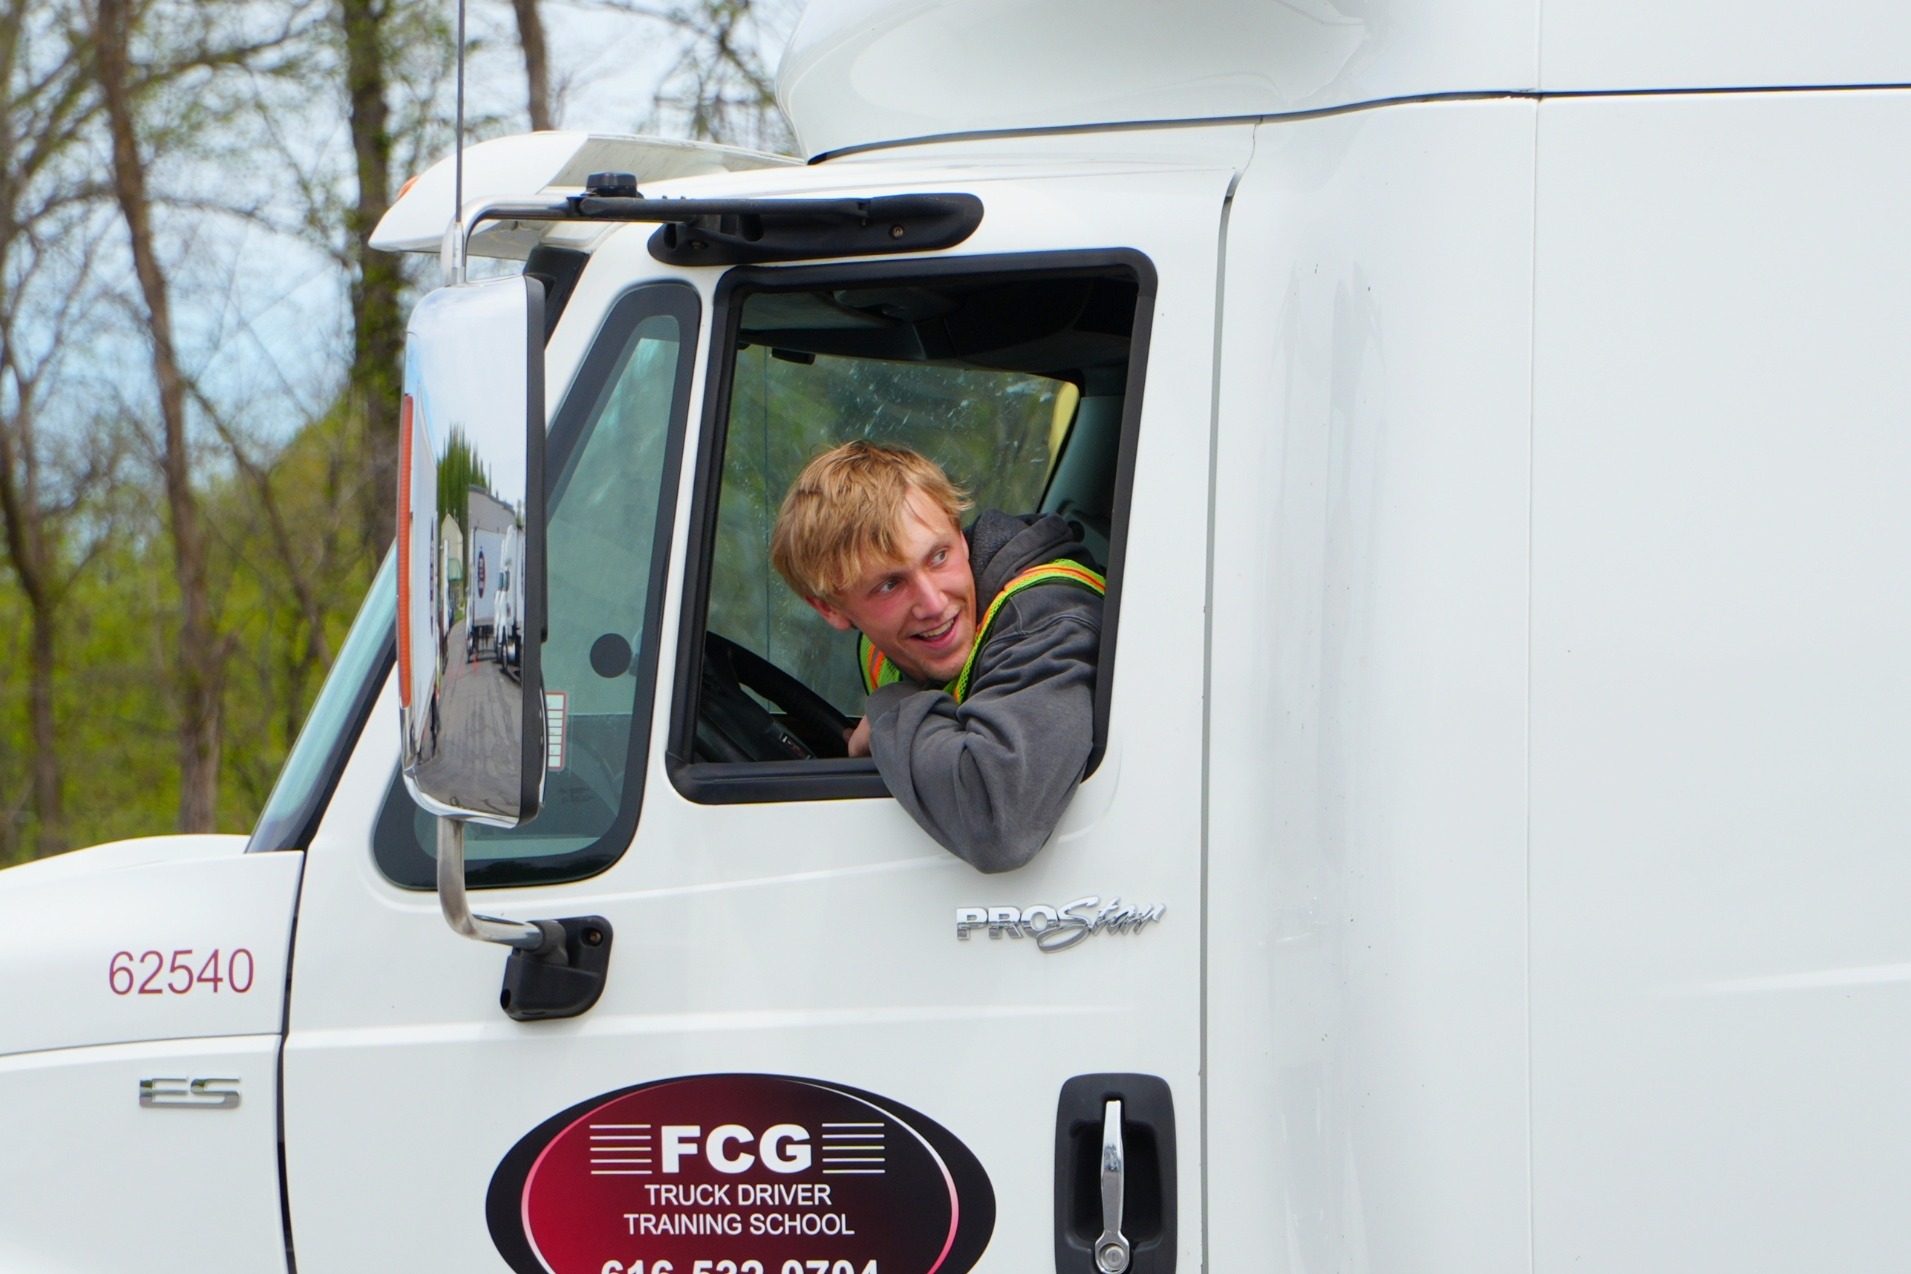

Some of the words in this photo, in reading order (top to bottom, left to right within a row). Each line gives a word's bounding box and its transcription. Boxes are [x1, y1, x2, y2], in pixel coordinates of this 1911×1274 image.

[109, 948, 254, 995] 62540
[139, 1076, 242, 1109] ES
[661, 1123, 812, 1174] FCG
[644, 1183, 731, 1206] TRUCK
[737, 1183, 832, 1205] DRIVER
[623, 1213, 742, 1235] TRAINING
[749, 1213, 855, 1235] SCHOOL
